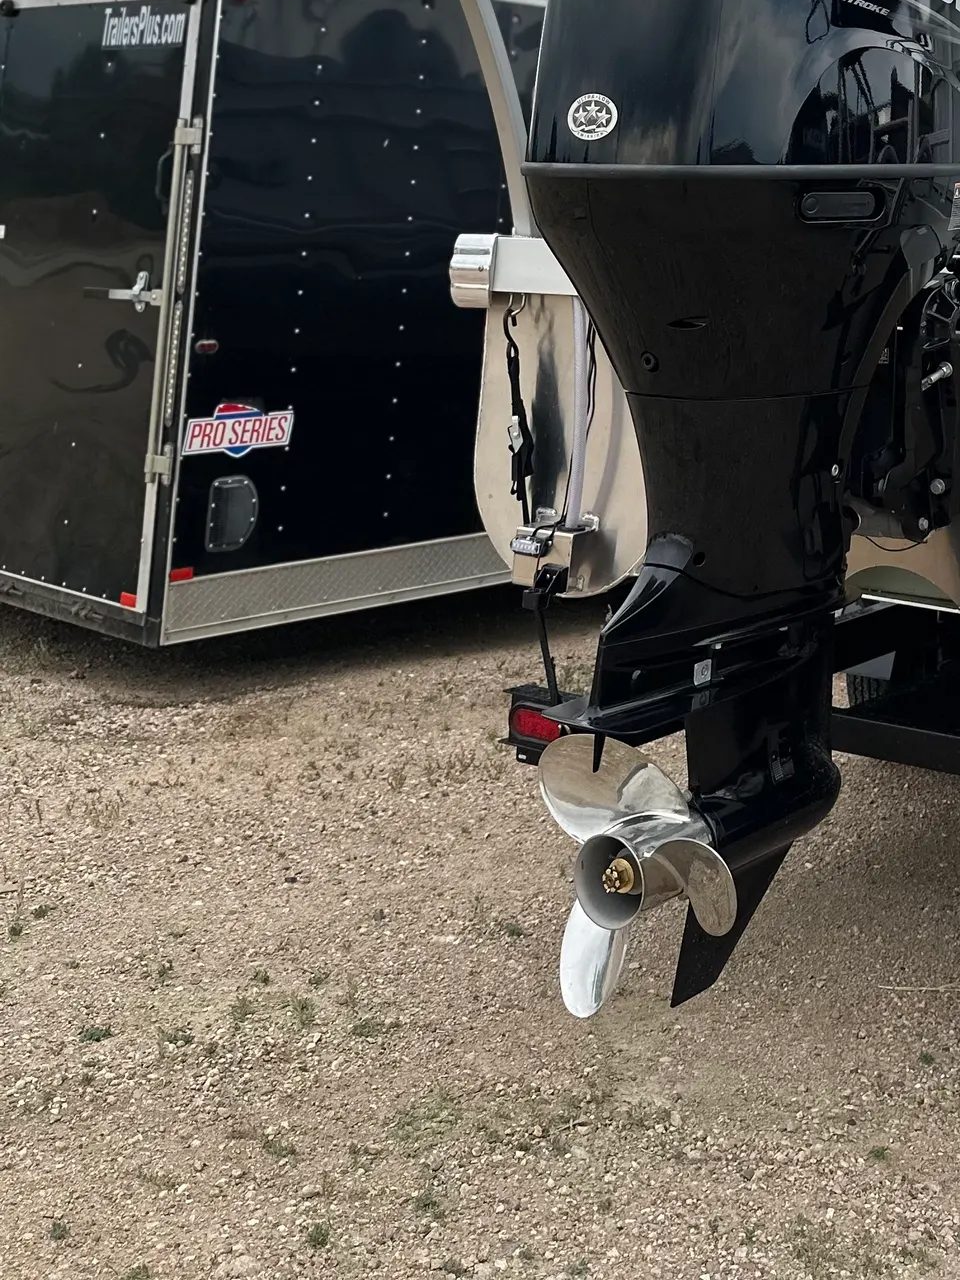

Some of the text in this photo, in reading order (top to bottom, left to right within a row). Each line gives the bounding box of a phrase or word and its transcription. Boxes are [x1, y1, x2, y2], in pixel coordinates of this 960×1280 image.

[102, 5, 186, 46] TrailersPlus.com
[188, 416, 288, 449] PRO SERIES
